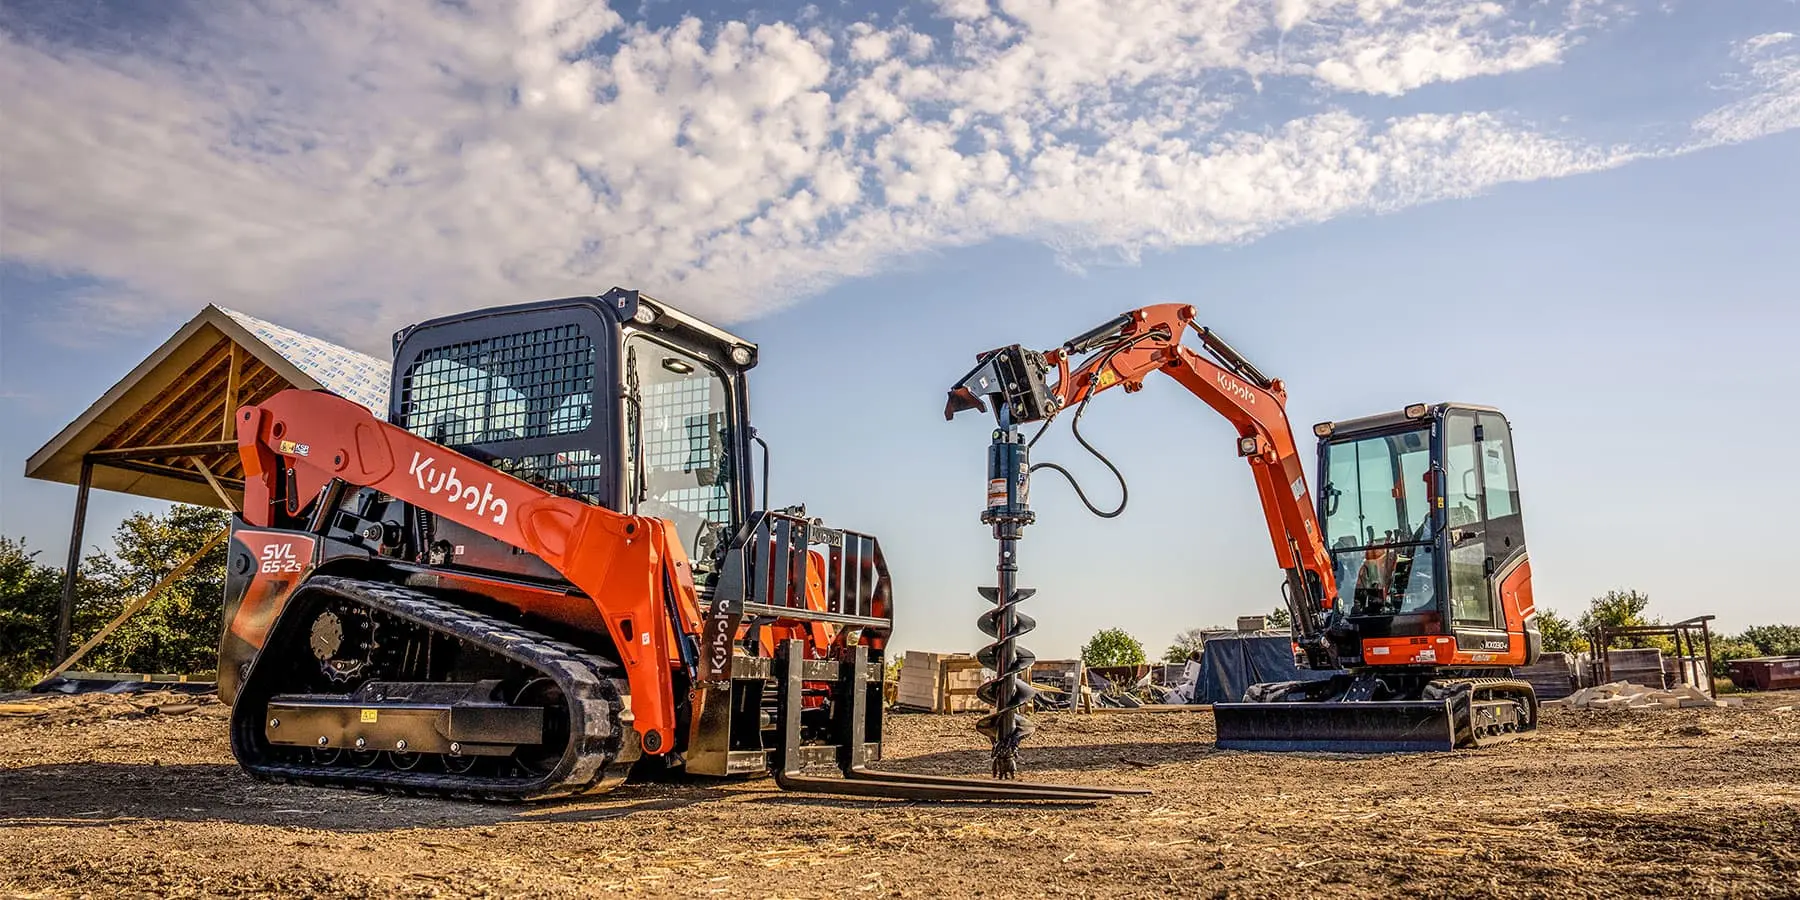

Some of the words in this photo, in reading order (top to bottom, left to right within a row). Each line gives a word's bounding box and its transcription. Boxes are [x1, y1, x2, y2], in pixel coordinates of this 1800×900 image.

[1217, 371, 1255, 404] Kubota
[409, 451, 508, 525] Kubota
[260, 544, 296, 560] SVL
[261, 560, 302, 573] 65-2s
[711, 600, 730, 673] Kubota
